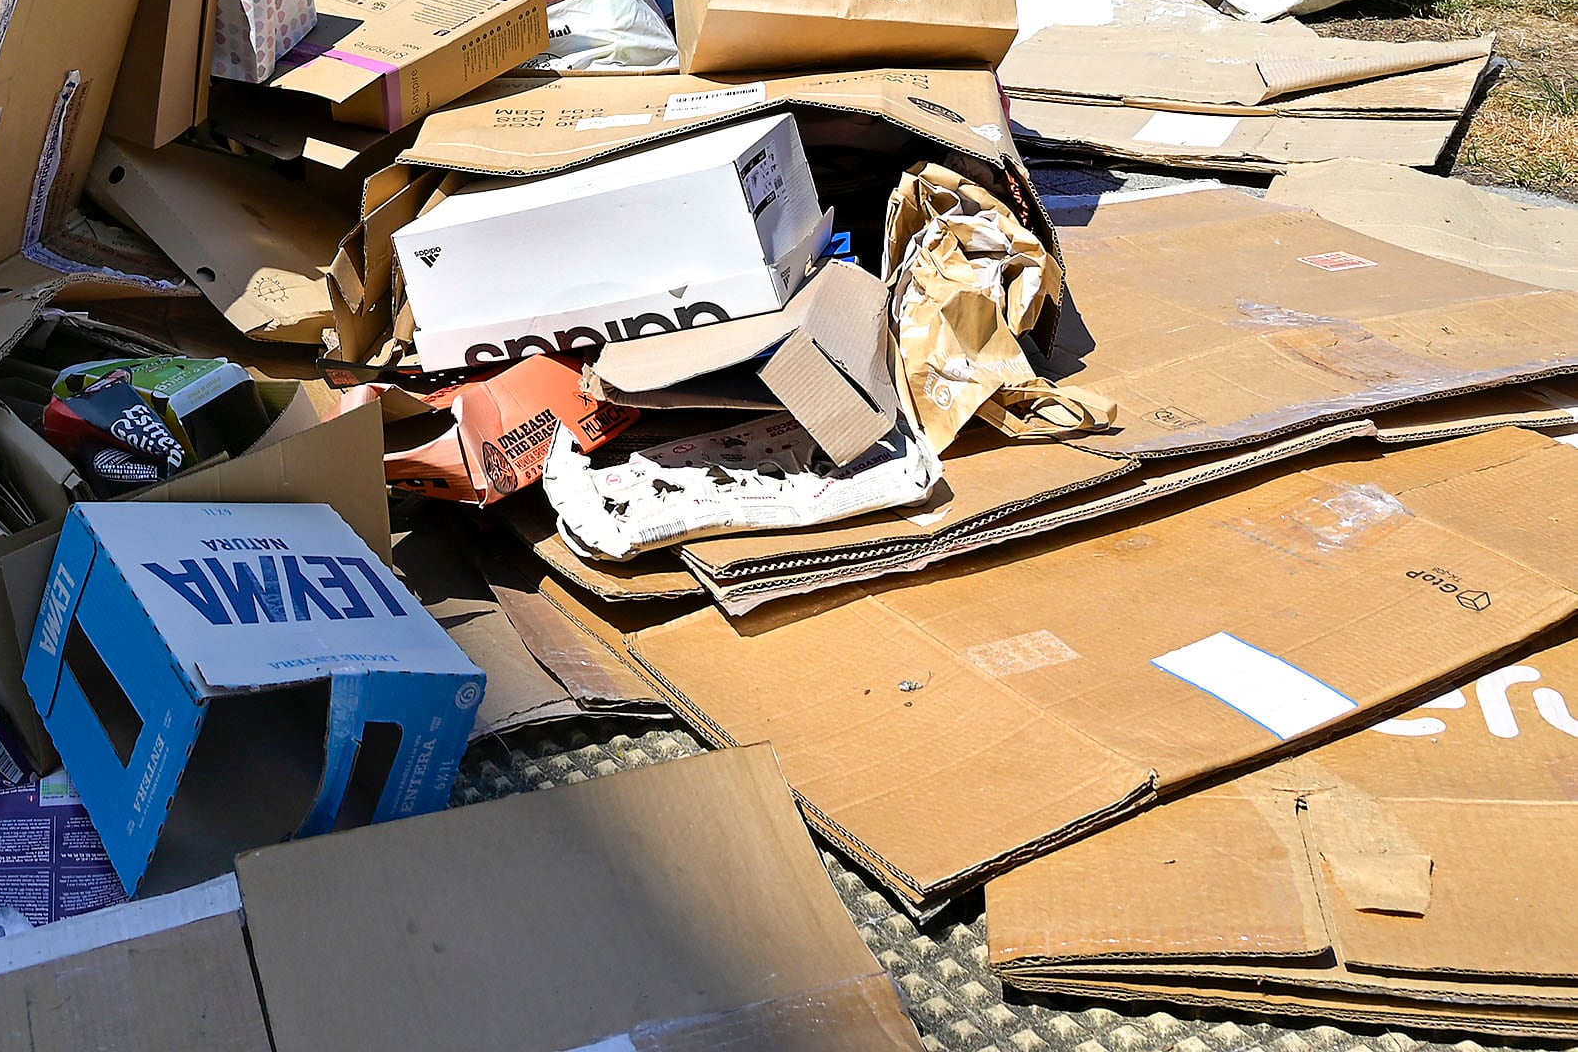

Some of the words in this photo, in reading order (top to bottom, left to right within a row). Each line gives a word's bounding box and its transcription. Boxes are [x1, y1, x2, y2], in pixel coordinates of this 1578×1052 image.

[495, 107, 547, 116] CBM
[495, 115, 545, 123] KGS
[414, 245, 442, 258] adidas
[498, 408, 557, 450] UNLEASH
[506, 440, 531, 460] THE
[201, 537, 290, 552] NATURA
[140, 554, 409, 626] LEYMA
[39, 563, 76, 657] LEYMA
[133, 733, 166, 813] ENTERA
[400, 738, 438, 813] ENTERA
